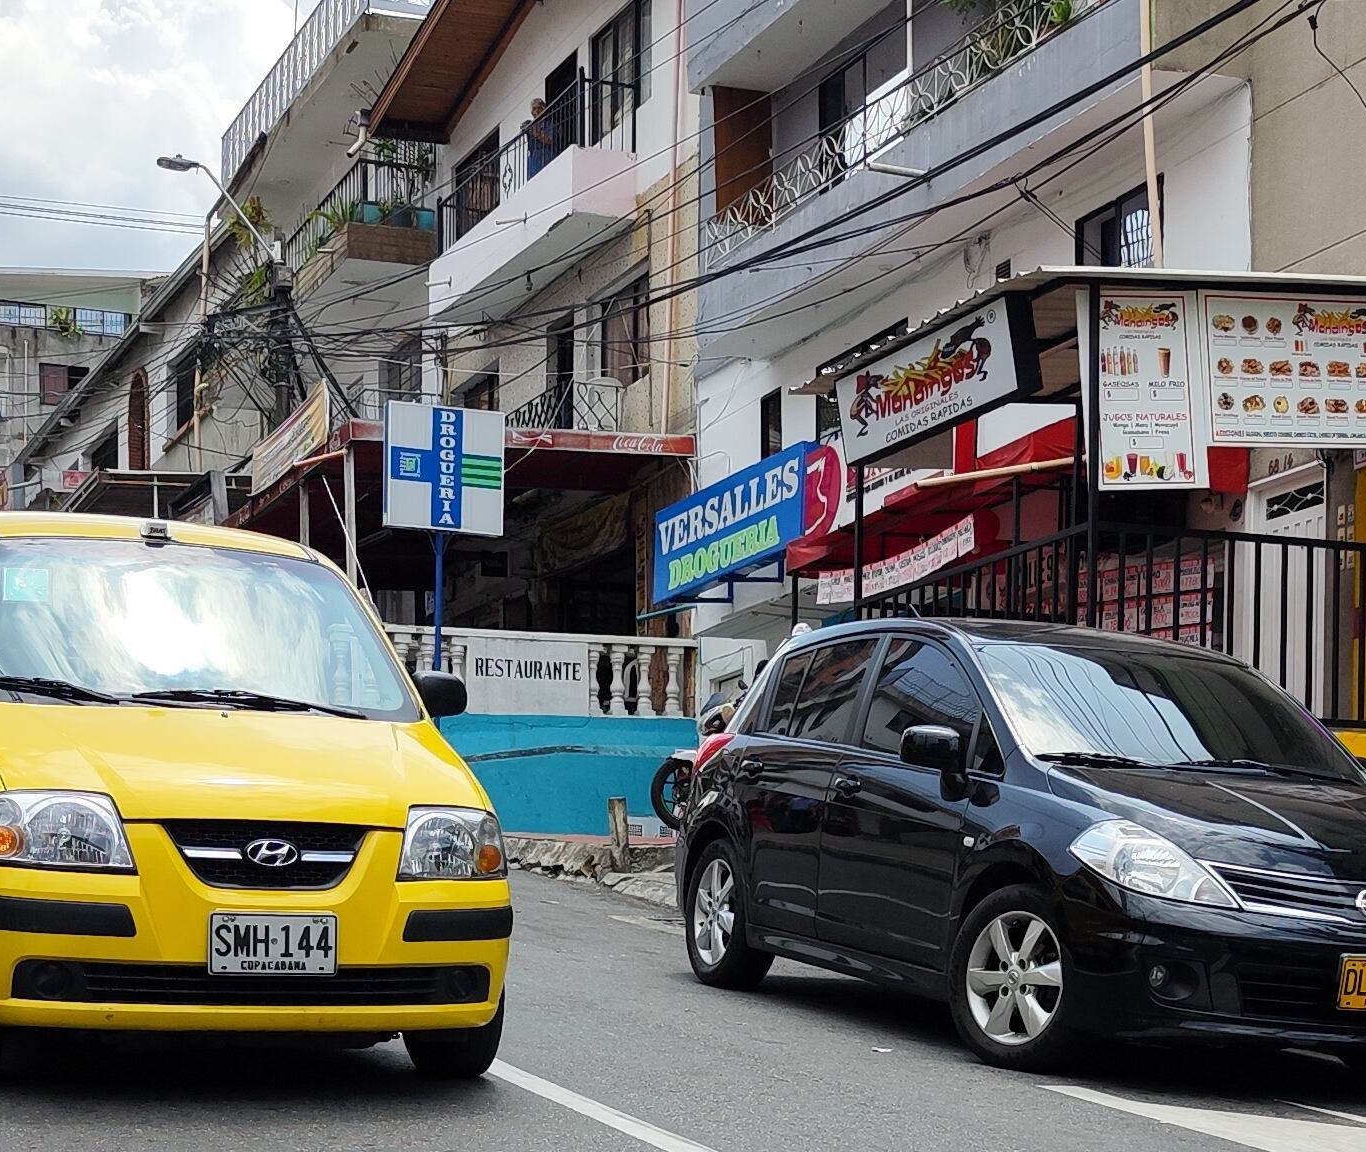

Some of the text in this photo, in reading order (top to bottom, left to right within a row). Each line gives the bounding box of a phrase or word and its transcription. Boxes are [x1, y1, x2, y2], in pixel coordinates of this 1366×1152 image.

[885, 395, 973, 443] COMIDAS RAPIDAS
[894, 391, 959, 426] LAS ORIGINALES
[1135, 412, 1188, 421] NATURALES
[438, 410, 457, 525] DROGUERIA
[658, 456, 800, 556] VERSALLES
[667, 514, 781, 591] DROGUERIA
[475, 657, 582, 682] RESTAURANTE
[240, 960, 307, 971] COPACABANA
